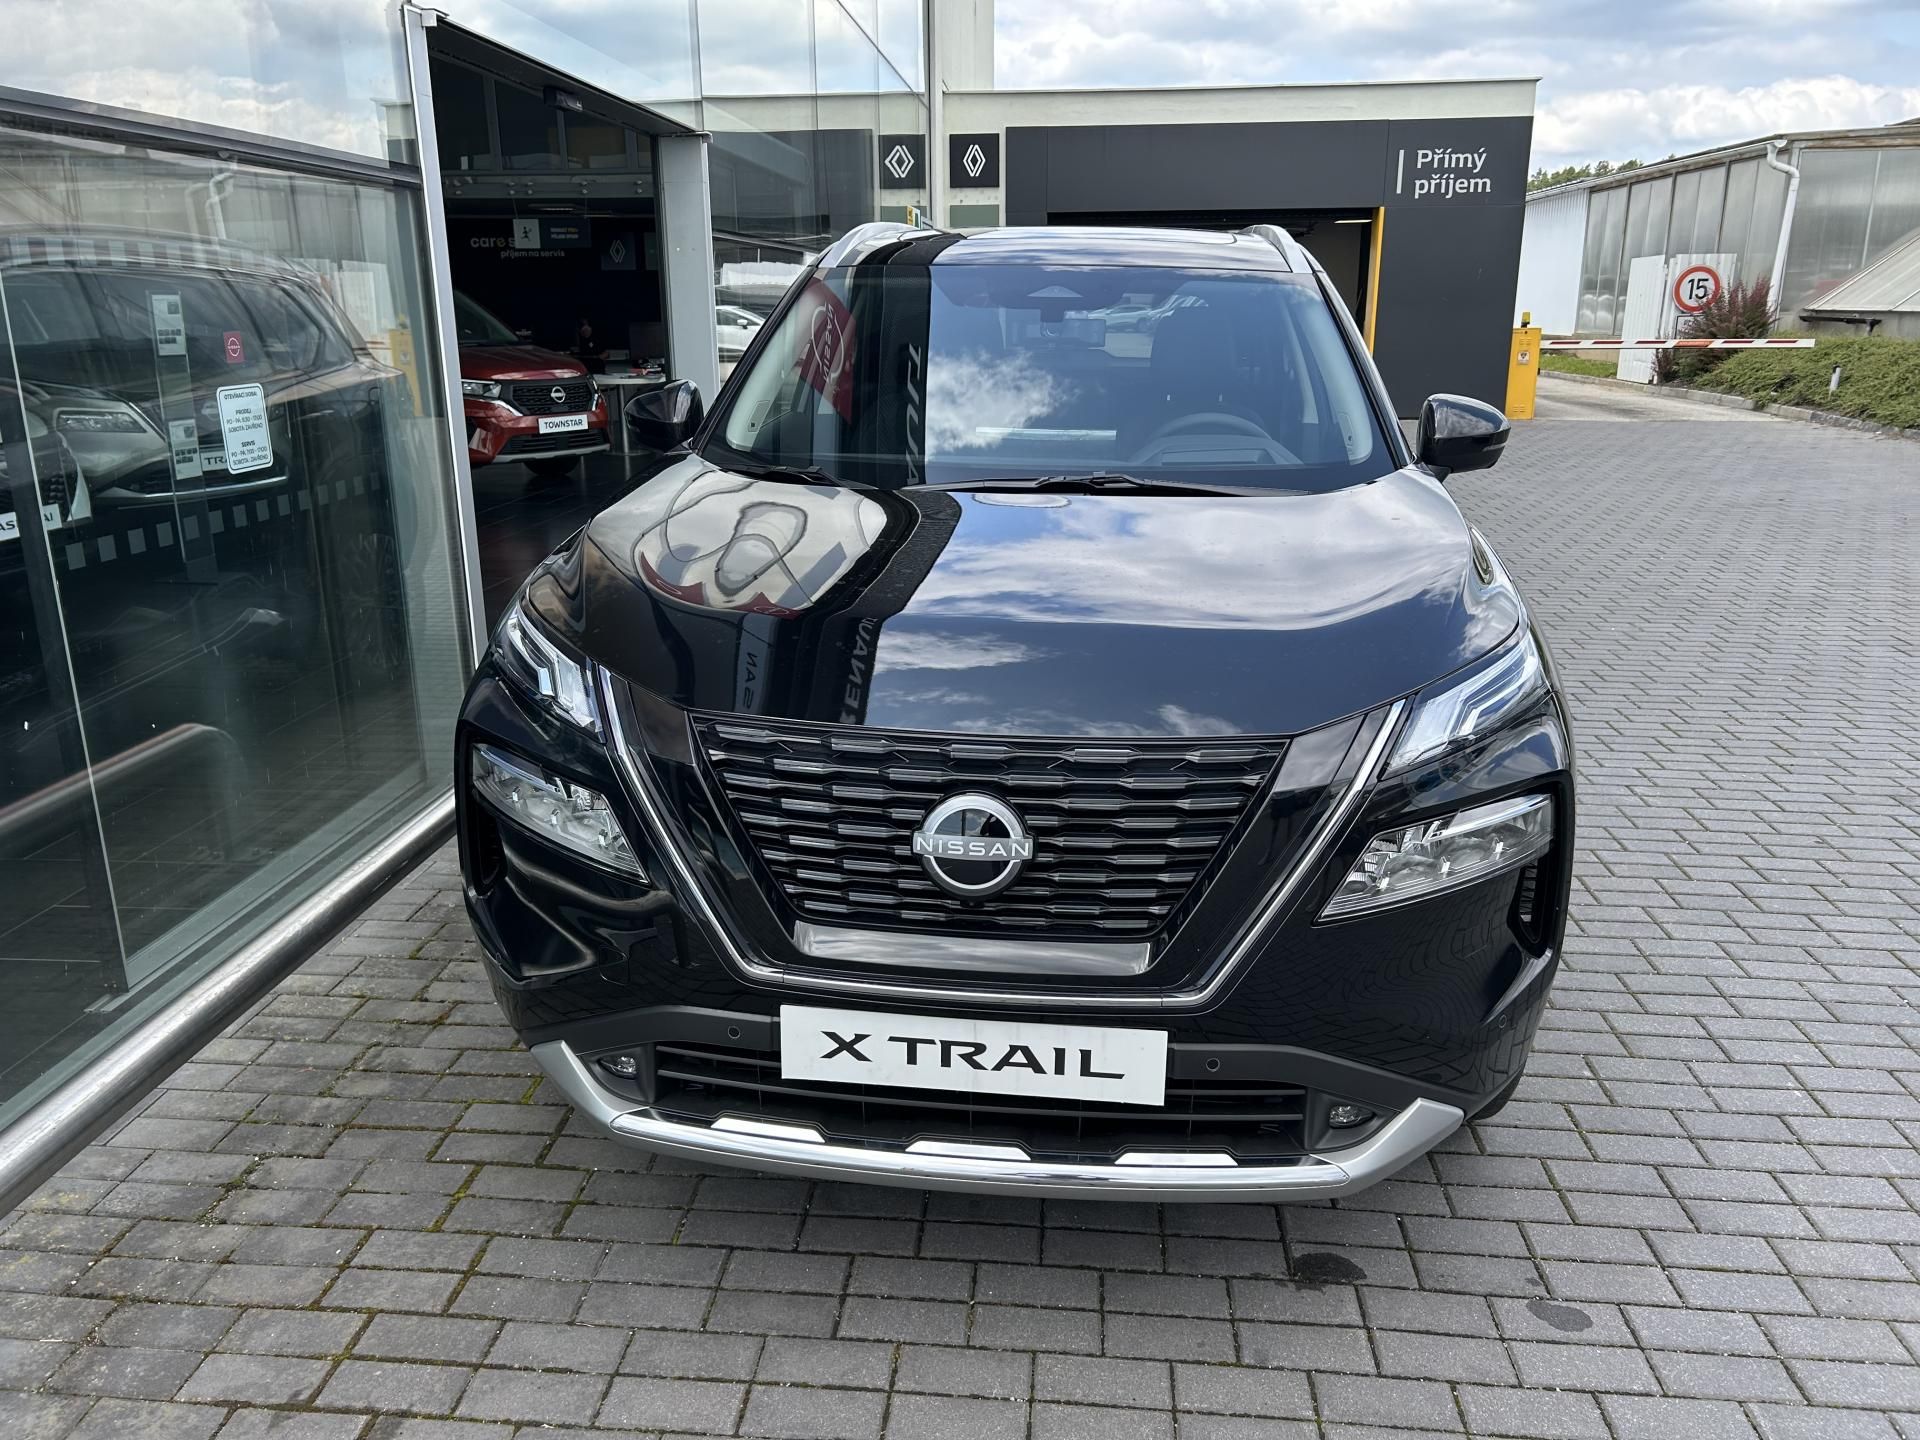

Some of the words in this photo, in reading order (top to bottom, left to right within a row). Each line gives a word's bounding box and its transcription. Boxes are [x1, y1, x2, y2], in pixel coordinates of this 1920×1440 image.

[1416, 147, 1487, 173] Přímý
[1414, 173, 1492, 199] příjem
[470, 236, 506, 248] care
[1687, 278, 1710, 300] 15
[544, 418, 583, 430] TOWNSTAR
[916, 836, 1029, 857] NISSAN
[819, 1030, 873, 1063] X
[887, 1034, 1126, 1080] TRAIL
